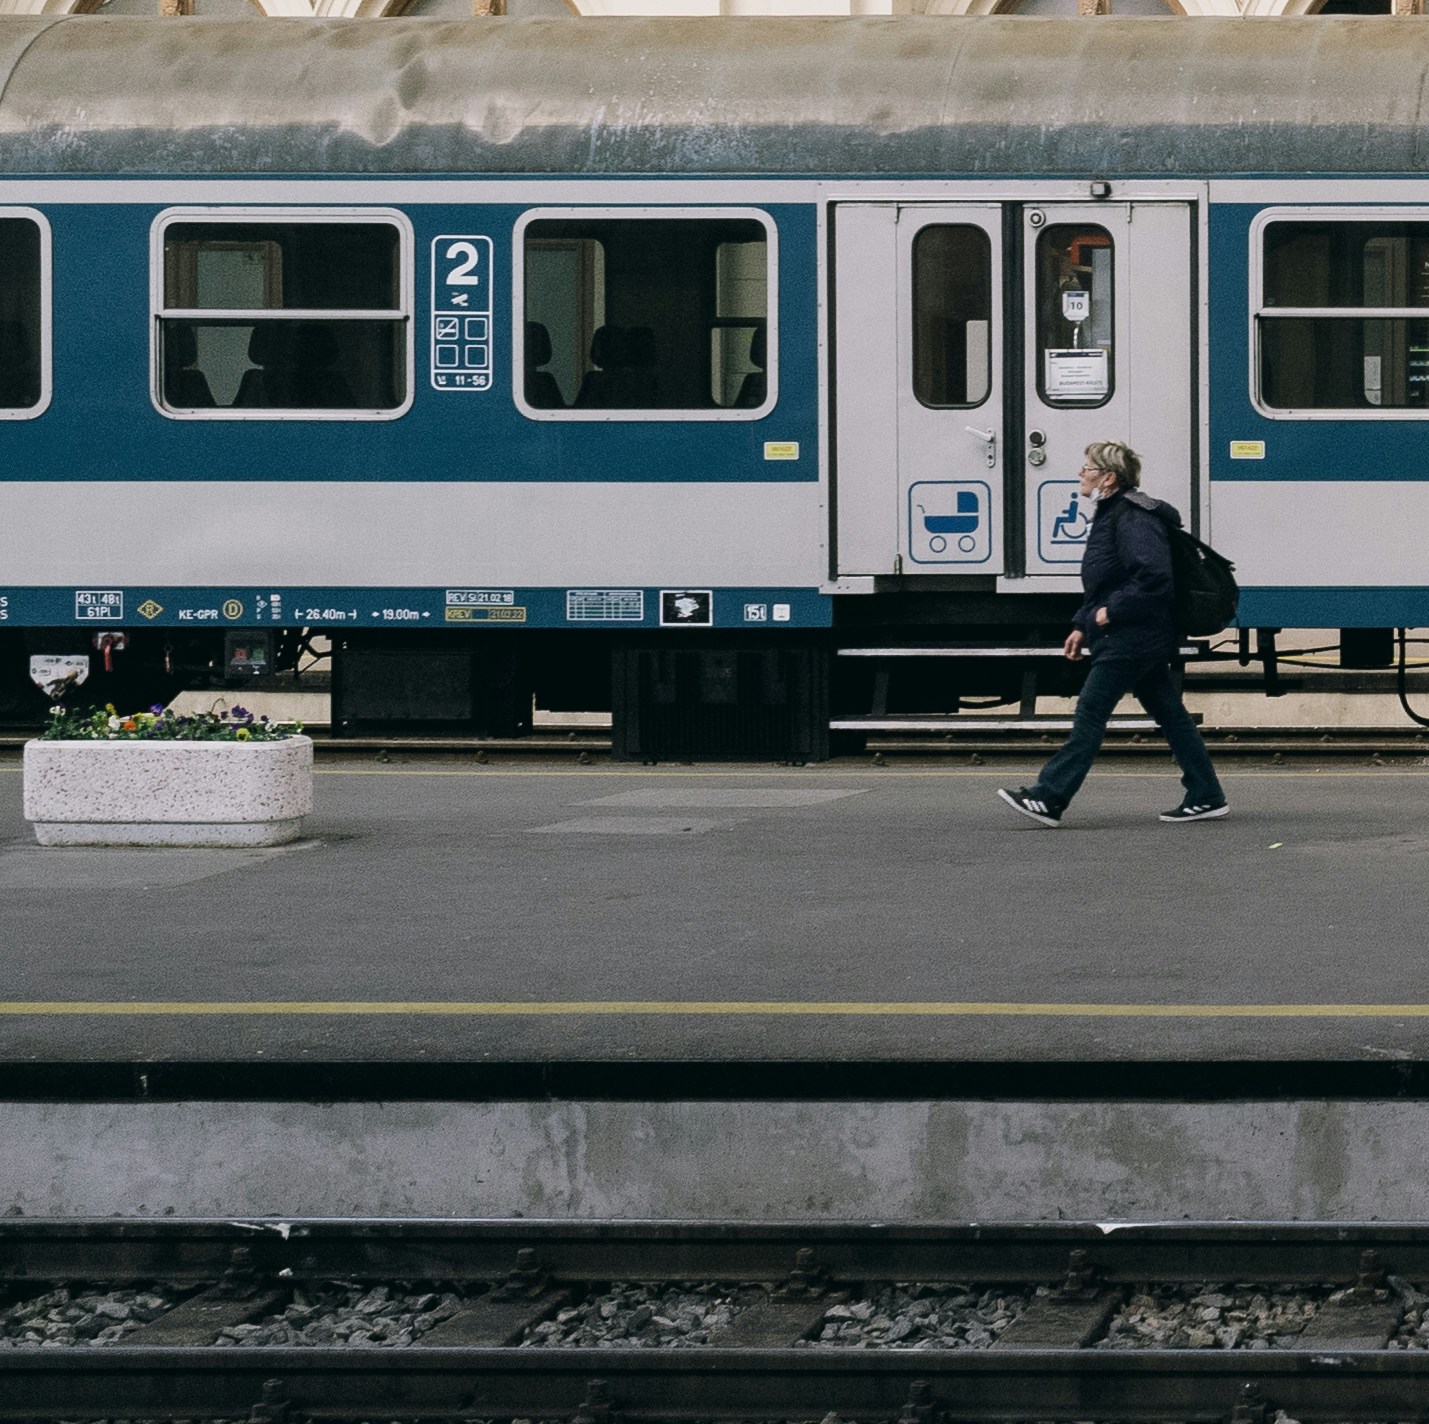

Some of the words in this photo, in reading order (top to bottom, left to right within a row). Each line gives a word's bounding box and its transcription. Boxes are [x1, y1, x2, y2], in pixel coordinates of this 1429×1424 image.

[446, 241, 479, 285] 2
[1070, 301, 1083, 310] 10
[178, 609, 219, 620] KE-GPR
[228, 604, 238, 615] D
[305, 608, 346, 620] 26.40m
[382, 608, 420, 620] 19.00m
